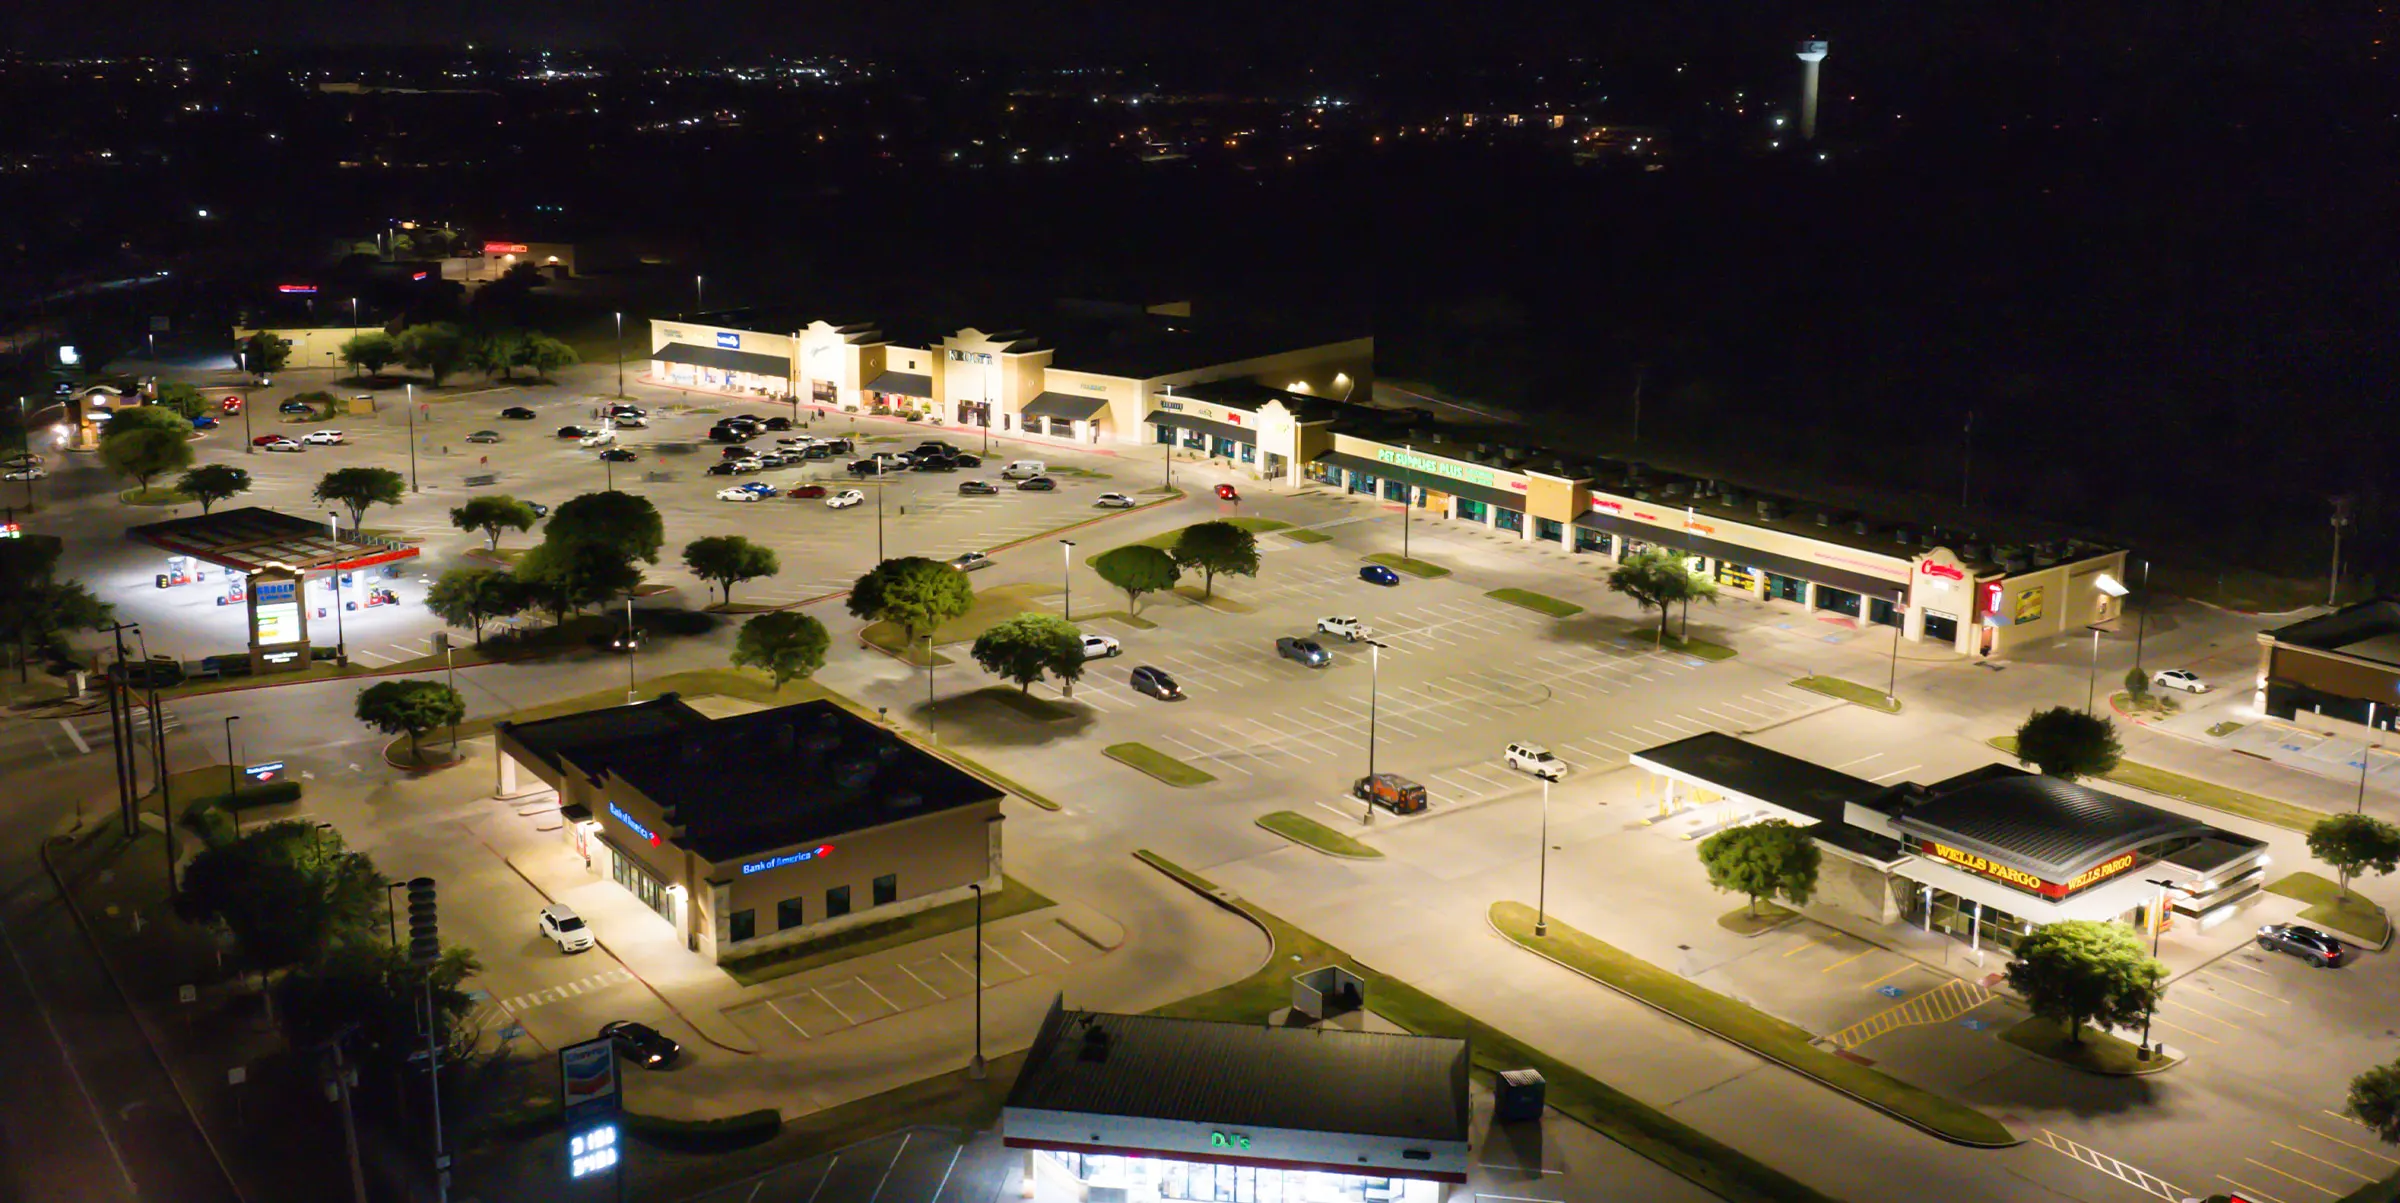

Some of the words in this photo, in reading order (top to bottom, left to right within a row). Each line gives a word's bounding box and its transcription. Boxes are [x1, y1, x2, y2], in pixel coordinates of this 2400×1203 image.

[949, 350, 993, 366] KOGR
[1378, 449, 1395, 463] PET
[743, 861, 766, 874] Bank
[766, 858, 776, 869] of
[776, 852, 811, 867] America
[1934, 843, 1987, 874] WELLS
[1987, 859, 2041, 889] FARGO
[2068, 869, 2101, 891] WELLS
[2100, 855, 2132, 878] FARGO
[1211, 1131, 1251, 1151] DJ's
